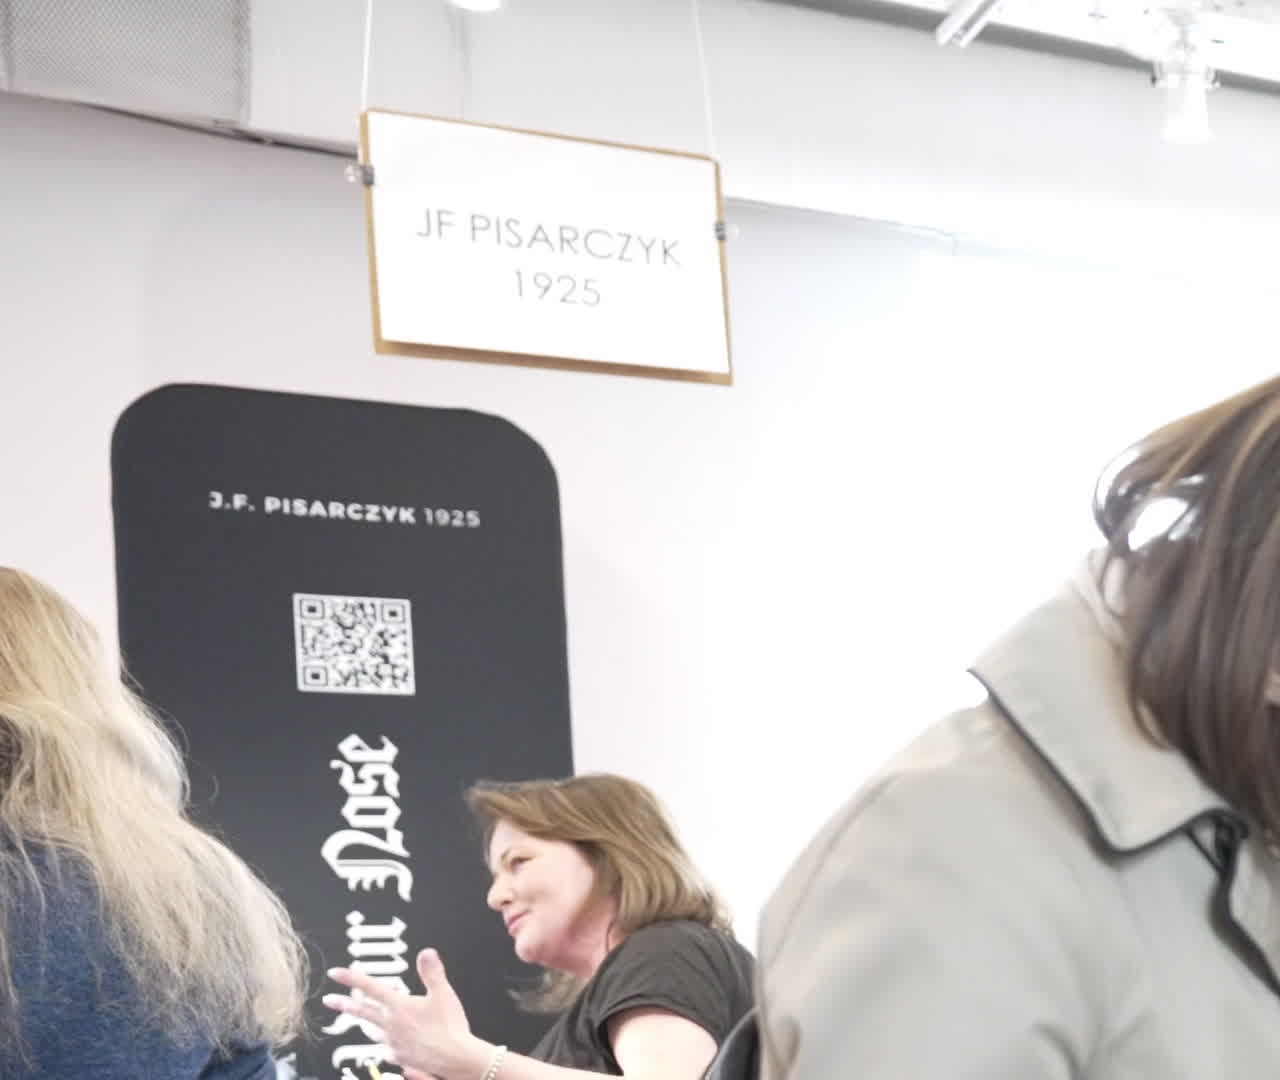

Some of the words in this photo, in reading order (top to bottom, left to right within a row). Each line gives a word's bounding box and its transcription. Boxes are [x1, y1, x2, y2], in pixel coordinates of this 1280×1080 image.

[417, 207, 456, 239] JF
[470, 212, 682, 266] PISARCZYK
[515, 270, 601, 307] 1925
[209, 491, 256, 512] J.F.
[265, 496, 416, 524] PISARCZYK
[424, 507, 481, 528] 1925
[321, 733, 413, 902] Nose
[321, 911, 410, 1070] Yur
